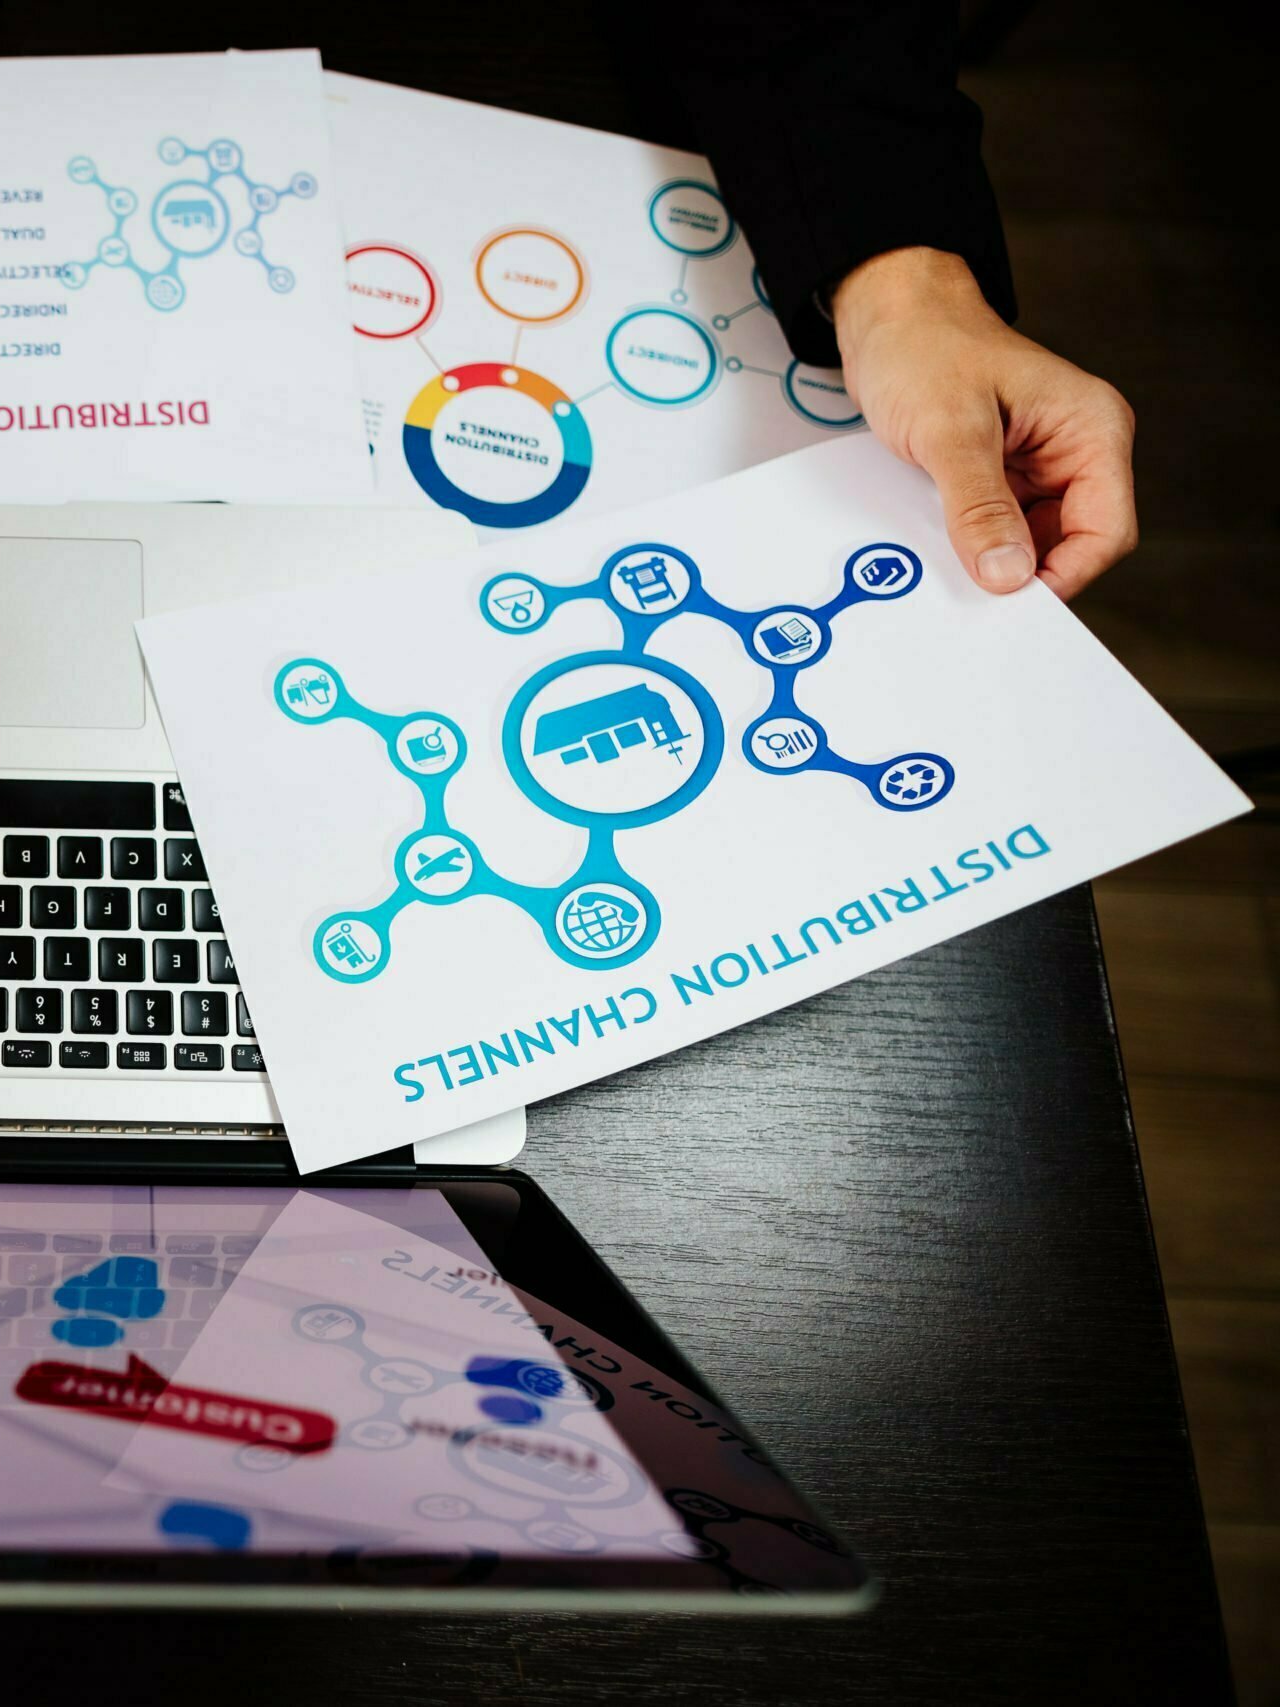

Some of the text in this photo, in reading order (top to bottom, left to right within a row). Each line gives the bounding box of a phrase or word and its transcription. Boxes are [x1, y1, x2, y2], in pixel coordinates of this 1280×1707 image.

[0, 228, 45, 240] DUAL
[504, 272, 557, 290] DIRECT
[0, 343, 60, 357] DIRECT
[628, 347, 698, 369] INDIRECT
[461, 423, 539, 447] CHANNELS
[446, 434, 548, 465] DISTRIBUTION
[22, 850, 30, 862] B
[76, 851, 85, 863] V
[129, 852, 138, 864] C
[182, 853, 192, 865] X
[48, 901, 59, 913] G
[104, 903, 111, 914] F
[157, 903, 167, 915] D
[8, 952, 17, 964] Y
[64, 953, 72, 965] T
[118, 954, 126, 966] R
[173, 955, 180, 967] E
[394, 824, 1051, 1102] DISTRIBUTION CHANNELS
[36, 996, 44, 1008] 6
[92, 997, 99, 1009] 5
[146, 999, 155, 1010] 4
[202, 999, 209, 1011] 3
[53, 1373, 303, 1443] Customer
